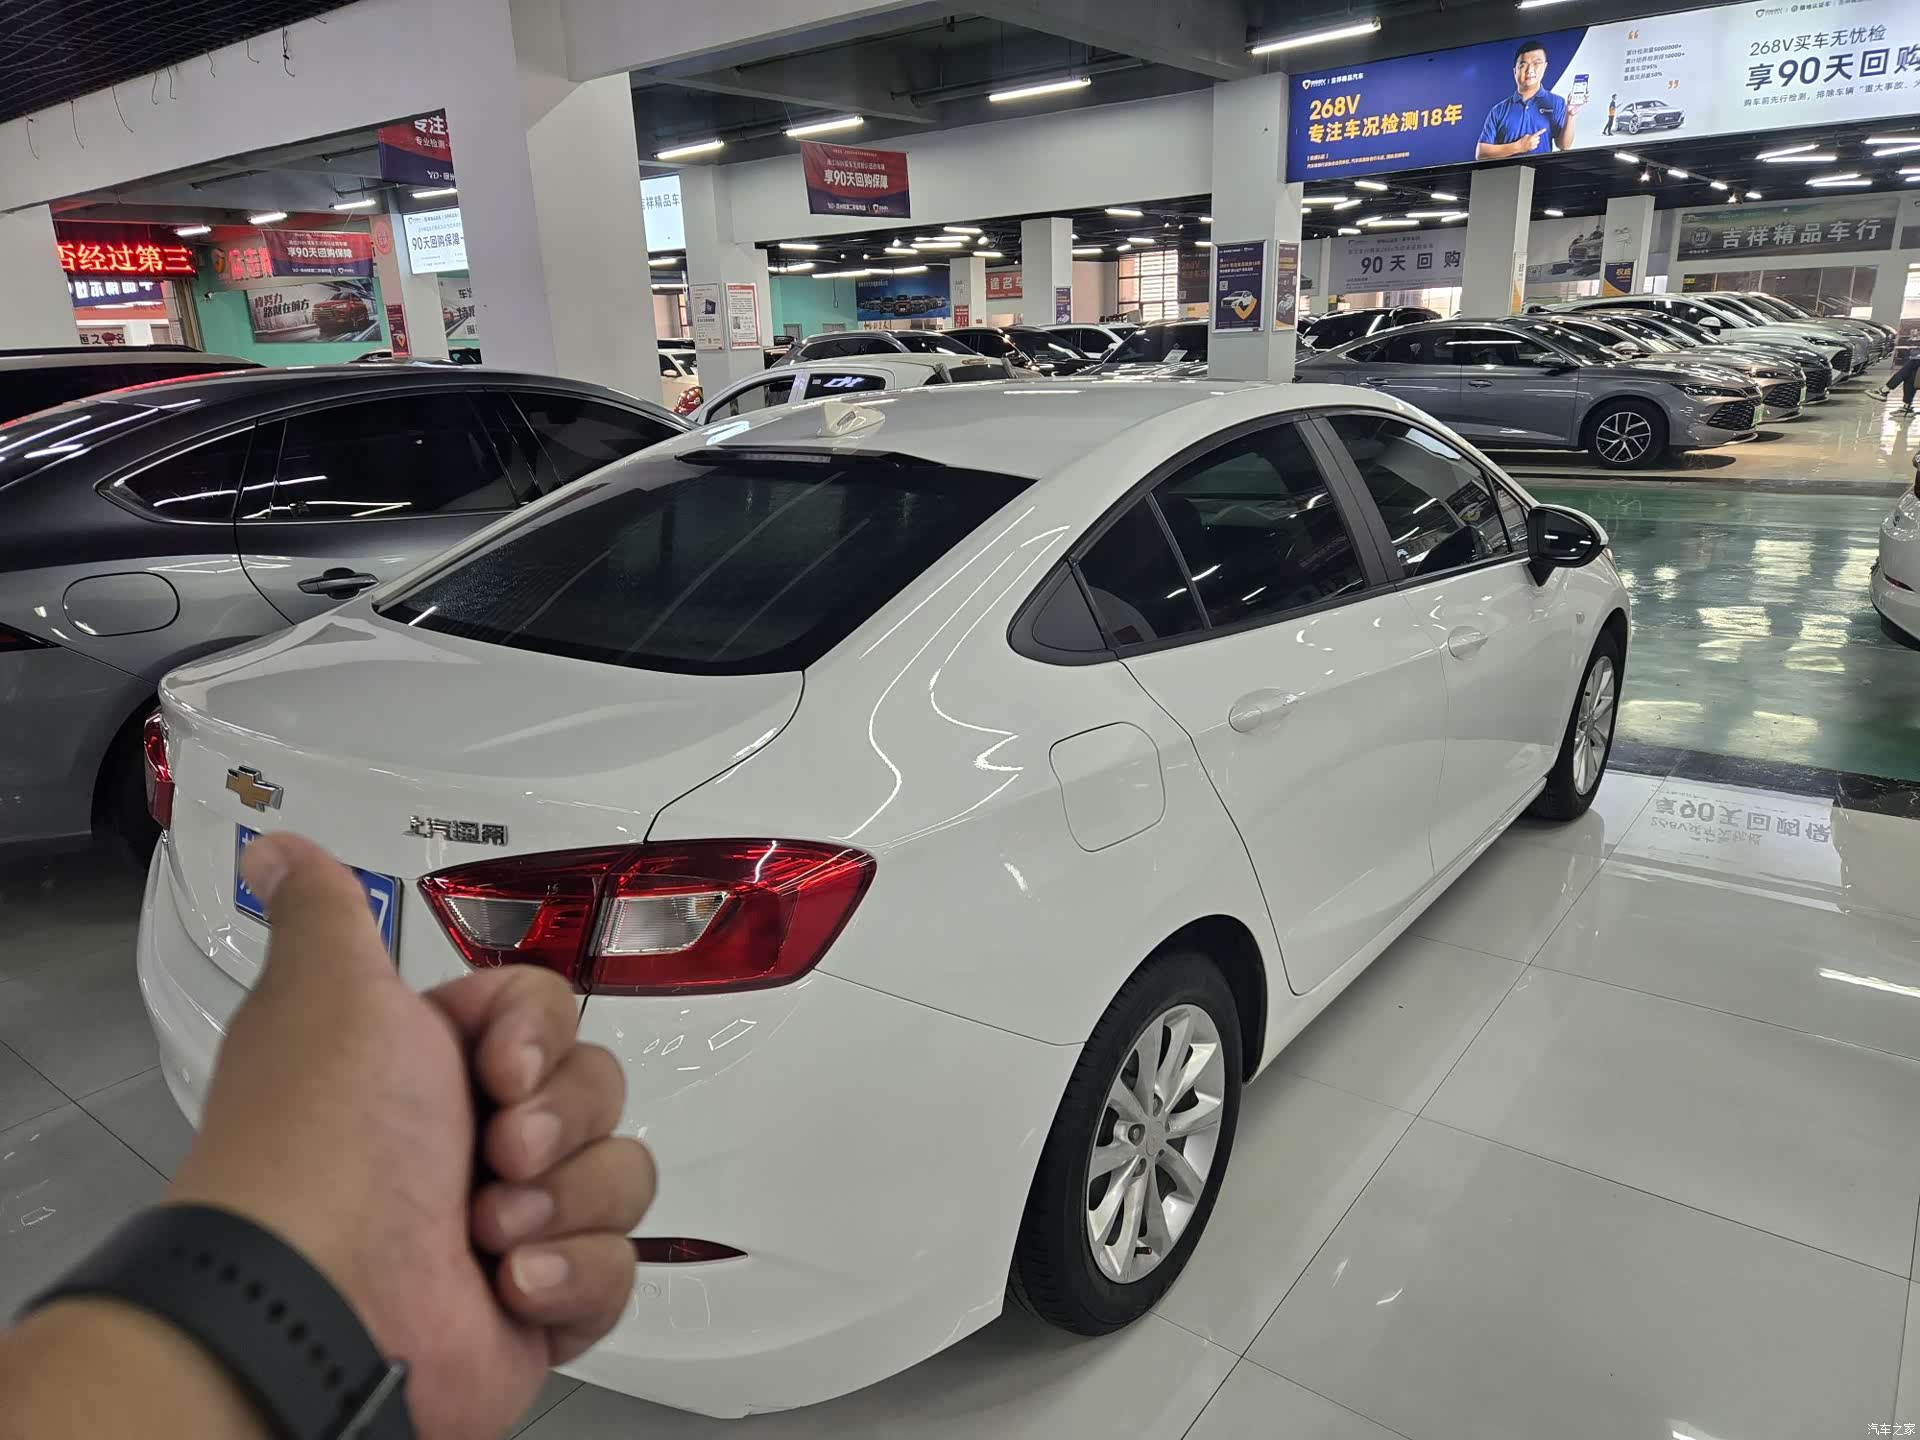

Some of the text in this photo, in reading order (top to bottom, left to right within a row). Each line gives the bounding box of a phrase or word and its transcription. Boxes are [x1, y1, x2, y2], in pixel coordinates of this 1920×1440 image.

[1749, 24, 1887, 57] 268V买车无忧检
[1745, 43, 1920, 92] 享90天回购
[1309, 94, 1361, 121] 268V
[414, 115, 450, 135] 专注
[1308, 104, 1463, 144] 专注车况检测18年
[824, 168, 889, 190] 享90天回购保障
[411, 231, 464, 252] 90天回购保障
[1721, 218, 1882, 249] 吉祥精品车行
[57, 243, 193, 272] 否经过第三
[287, 247, 353, 260] 享90天回购保障
[263, 299, 310, 318] 路就在前方
[80, 332, 126, 345] 恒之名
